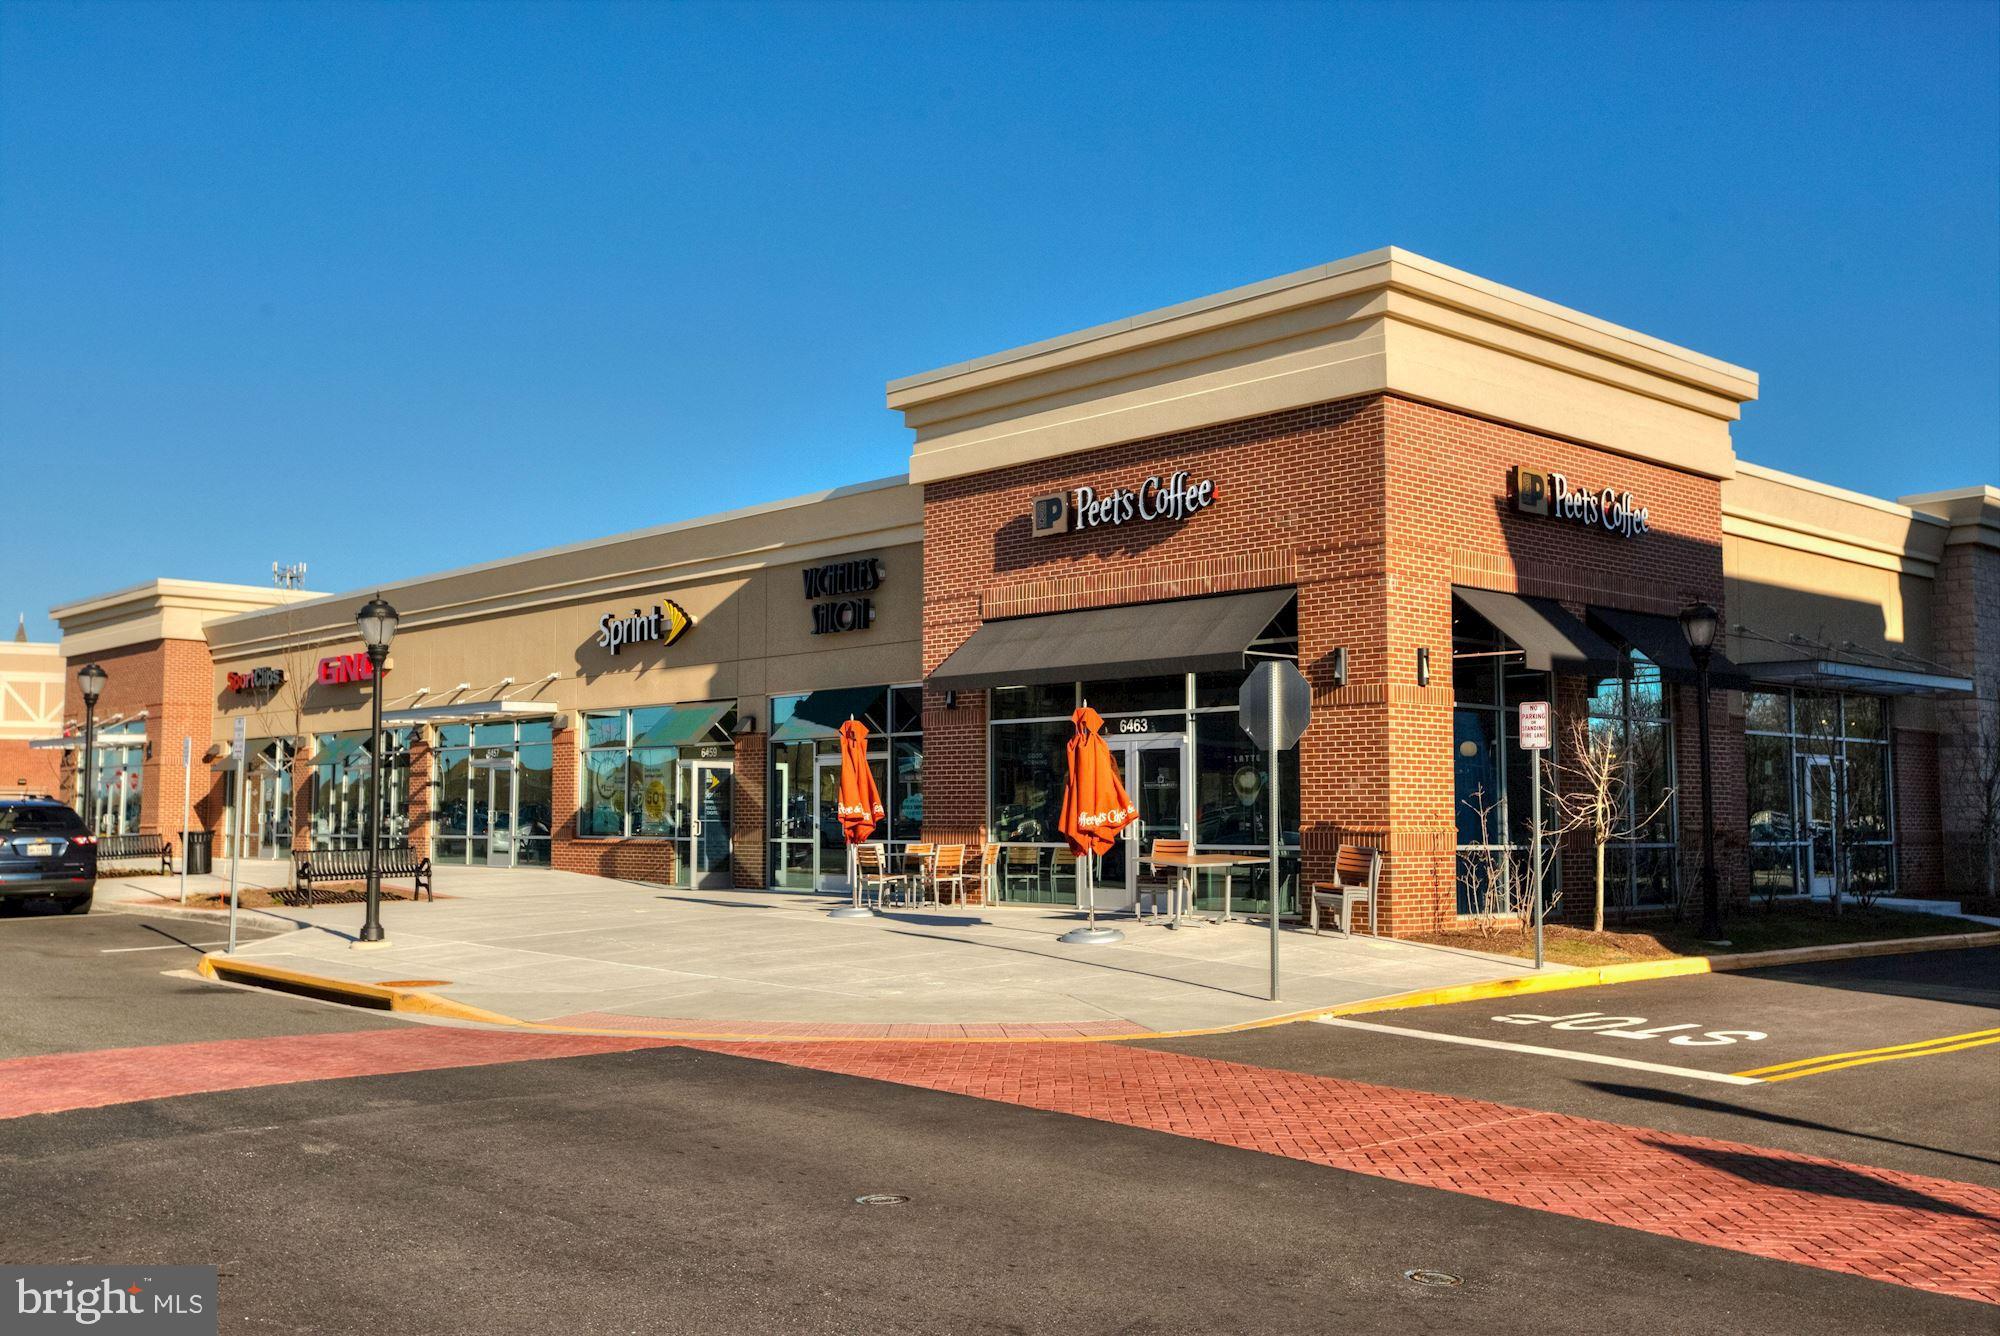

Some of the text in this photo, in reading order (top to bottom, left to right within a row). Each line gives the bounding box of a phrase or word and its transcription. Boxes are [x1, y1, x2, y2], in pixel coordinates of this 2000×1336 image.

[1074, 486, 1135, 530] Peet's
[1138, 471, 1213, 521] Coffee
[1552, 472, 1598, 525] Peet's
[1601, 487, 1650, 538] Coffee
[599, 606, 661, 655] Sprint
[811, 599, 869, 634] SALON
[1120, 718, 1148, 733] 6463
[701, 747, 717, 758] 6459
[1491, 1012, 1768, 1046] STOP
